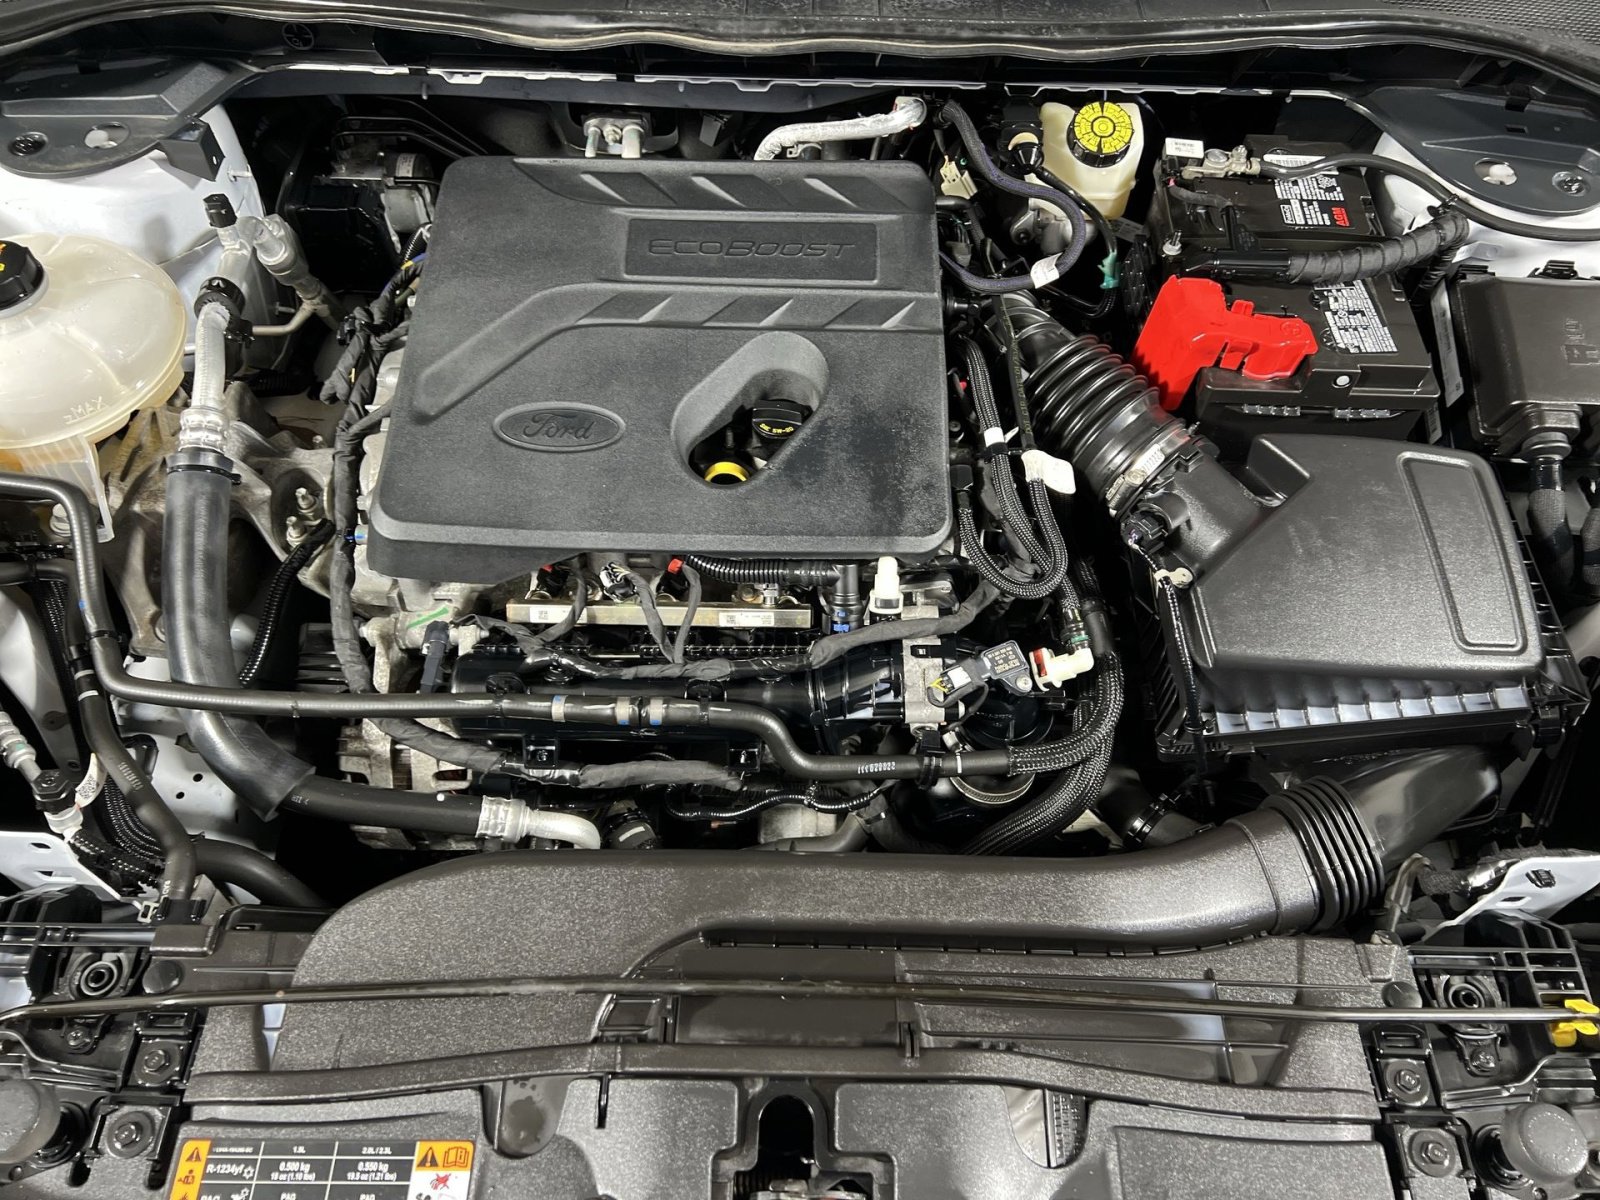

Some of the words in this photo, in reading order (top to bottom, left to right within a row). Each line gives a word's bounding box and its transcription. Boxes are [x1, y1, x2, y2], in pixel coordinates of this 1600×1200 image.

[1331, 207, 1346, 226] AGM
[71, 396, 107, 418] MAX
[522, 412, 596, 441] Ford
[206, 1163, 245, 1176] R-1234yf
[279, 1162, 300, 1171] 0.500
[300, 1162, 311, 1174] kg
[358, 1162, 378, 1171] 0.550
[379, 1162, 389, 1174] kg
